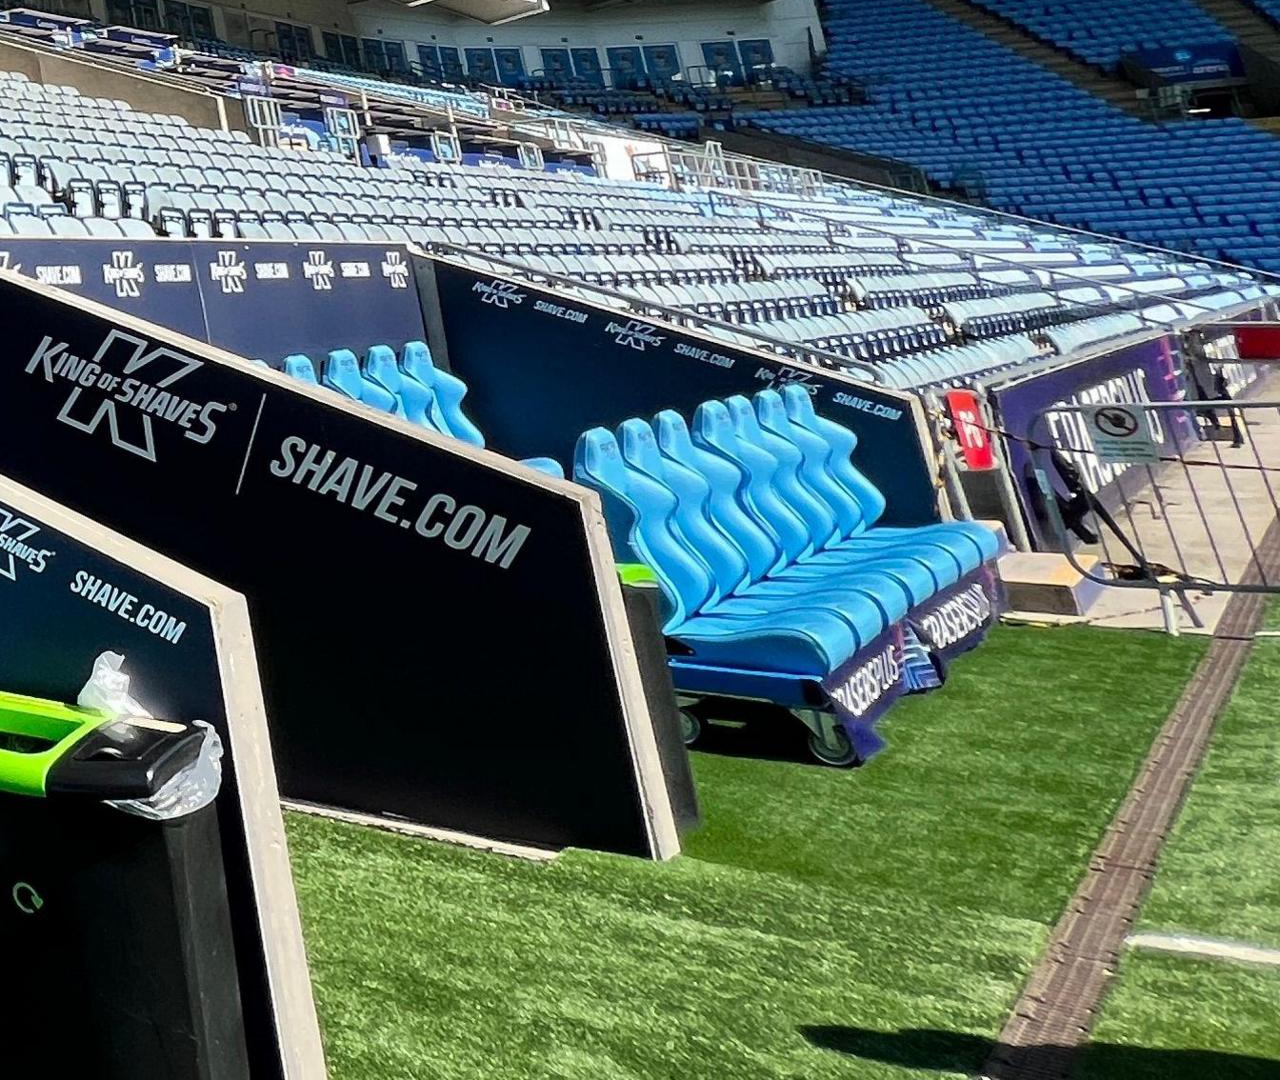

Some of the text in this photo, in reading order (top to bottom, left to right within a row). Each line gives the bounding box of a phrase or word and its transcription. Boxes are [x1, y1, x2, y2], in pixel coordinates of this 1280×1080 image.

[534, 300, 588, 324] SHAVE.COM
[674, 343, 735, 369] SHAVE.COM
[24, 335, 98, 387] KING
[120, 380, 227, 445] SHAVES
[832, 392, 903, 421] SHAVE.COM
[269, 435, 532, 570] SHAVE.COM
[69, 570, 188, 645] SHAVE.COM
